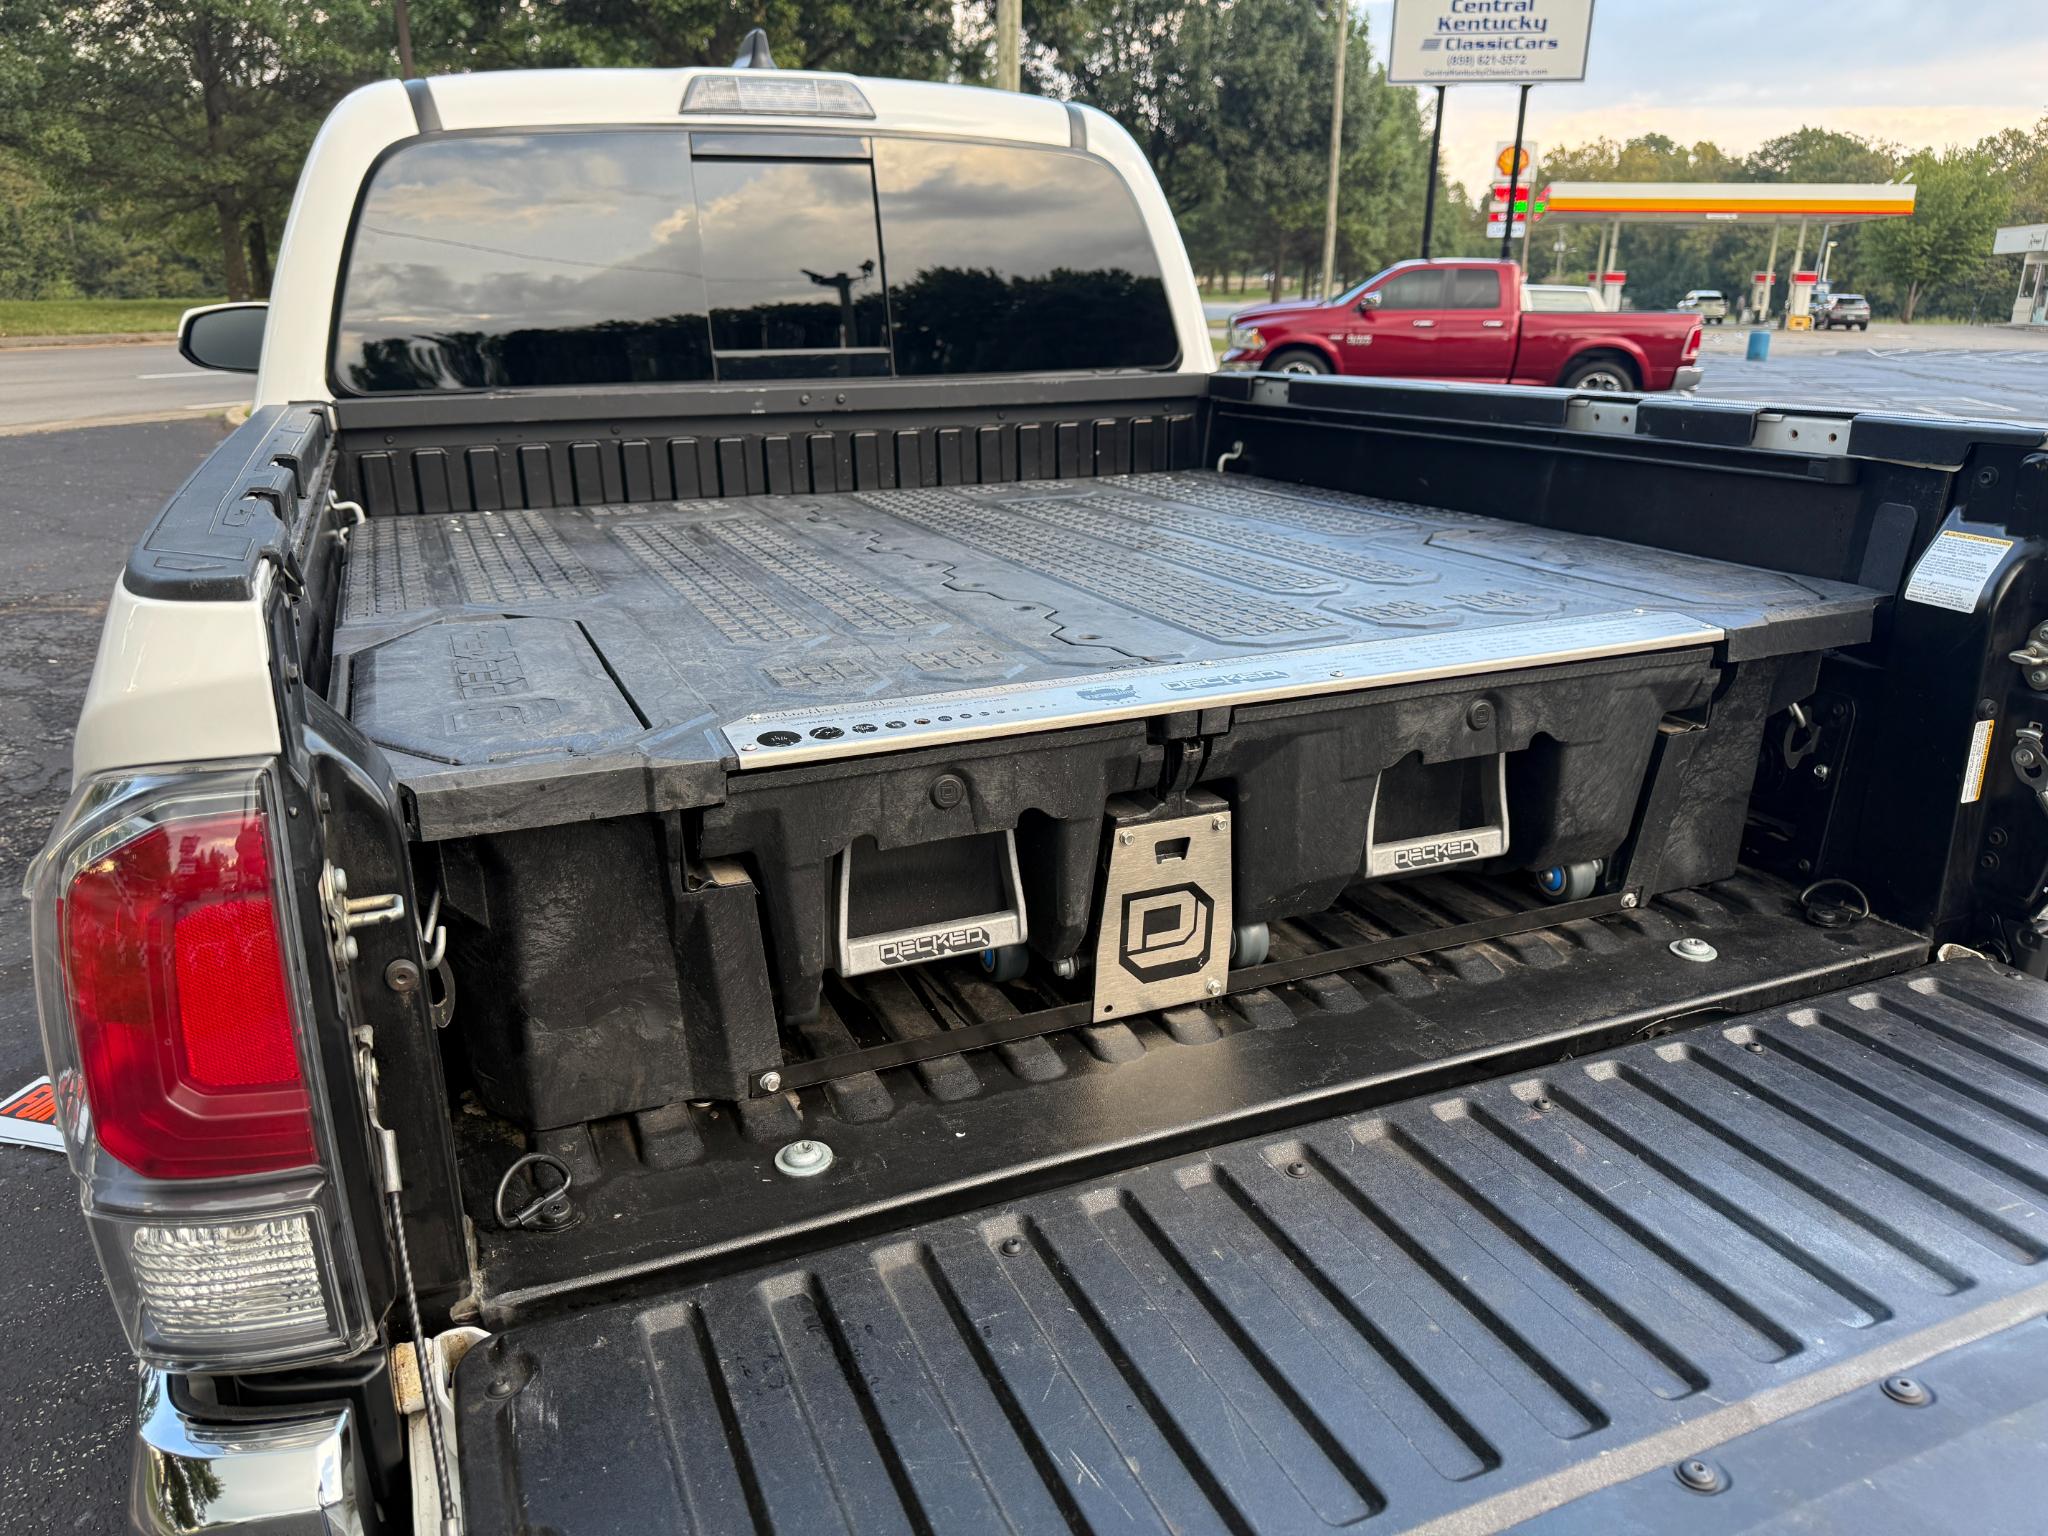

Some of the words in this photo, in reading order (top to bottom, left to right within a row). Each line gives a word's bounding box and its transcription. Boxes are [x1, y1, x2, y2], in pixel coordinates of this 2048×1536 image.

[1450, 0, 1535, 14] Central
[1437, 16, 1548, 33] Kentucky
[1444, 37, 1558, 50] ClassicCars
[1160, 670, 1290, 691] DECKED
[1395, 839, 1479, 869] DECKED
[879, 927, 990, 965] DECKED
